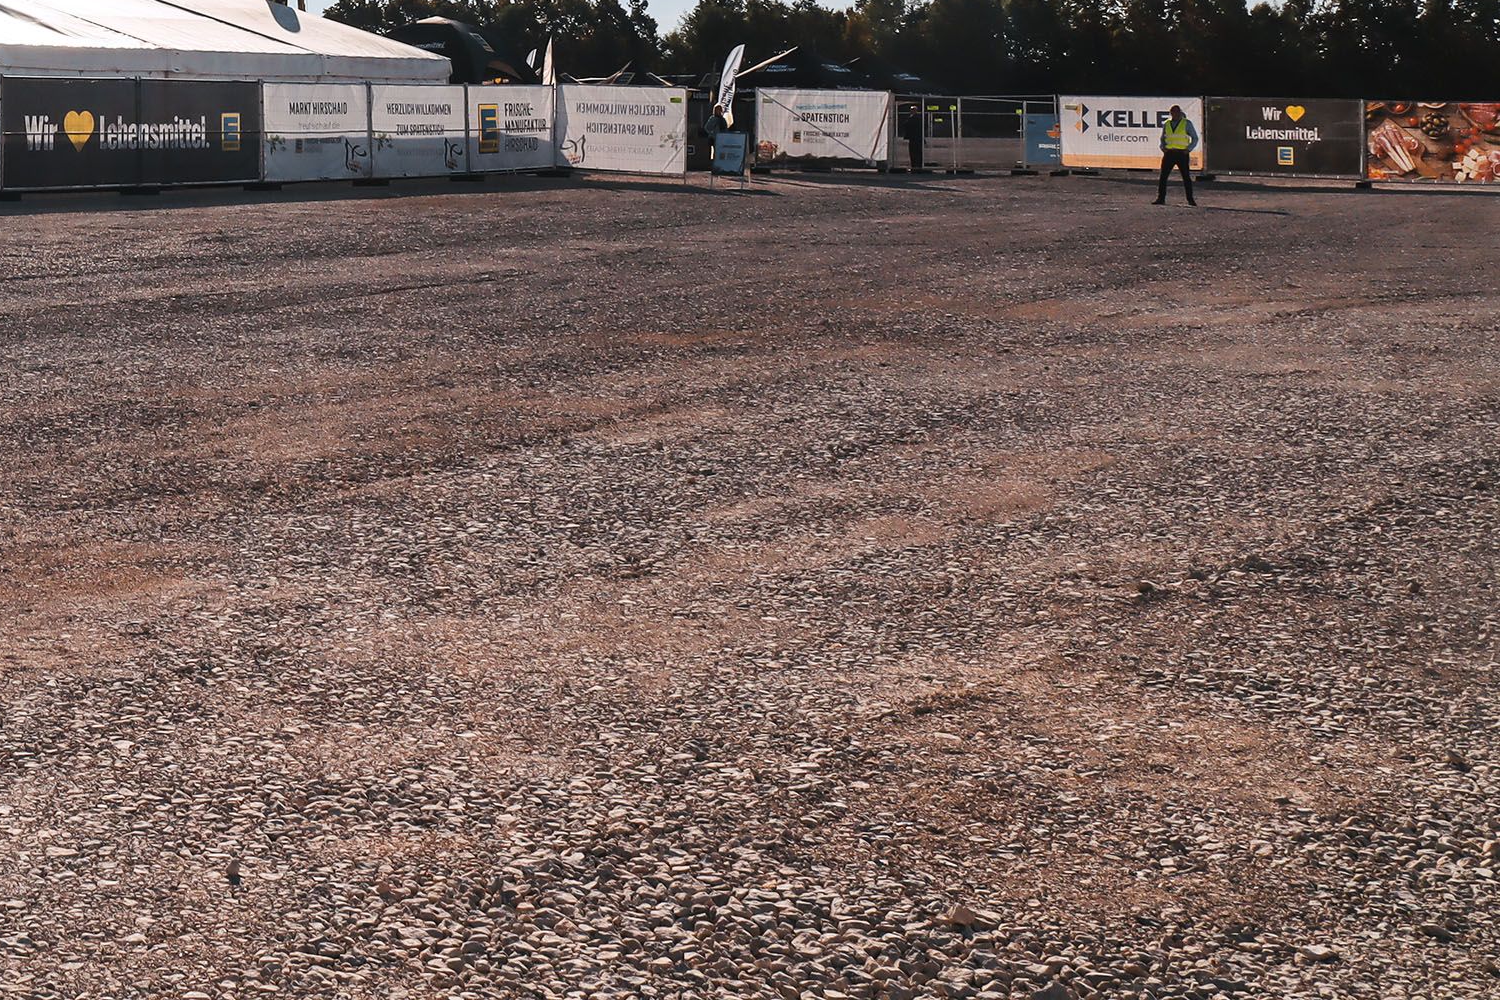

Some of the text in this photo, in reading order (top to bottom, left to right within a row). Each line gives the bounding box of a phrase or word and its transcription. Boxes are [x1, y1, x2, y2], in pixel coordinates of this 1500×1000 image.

[289, 102, 348, 115] MARKT HIRSCHAID
[386, 103, 451, 115] HERZLICH WILLKOMMEN
[504, 102, 534, 117] FRISCHE-
[1262, 106, 1283, 121] Wir
[801, 112, 850, 124] SPATENSTICH
[1097, 110, 1172, 128] KELLE
[24, 114, 210, 151] Wir Lebensmittel.
[504, 118, 546, 134] MANUFAKTUR
[1097, 132, 1149, 143] keller.com
